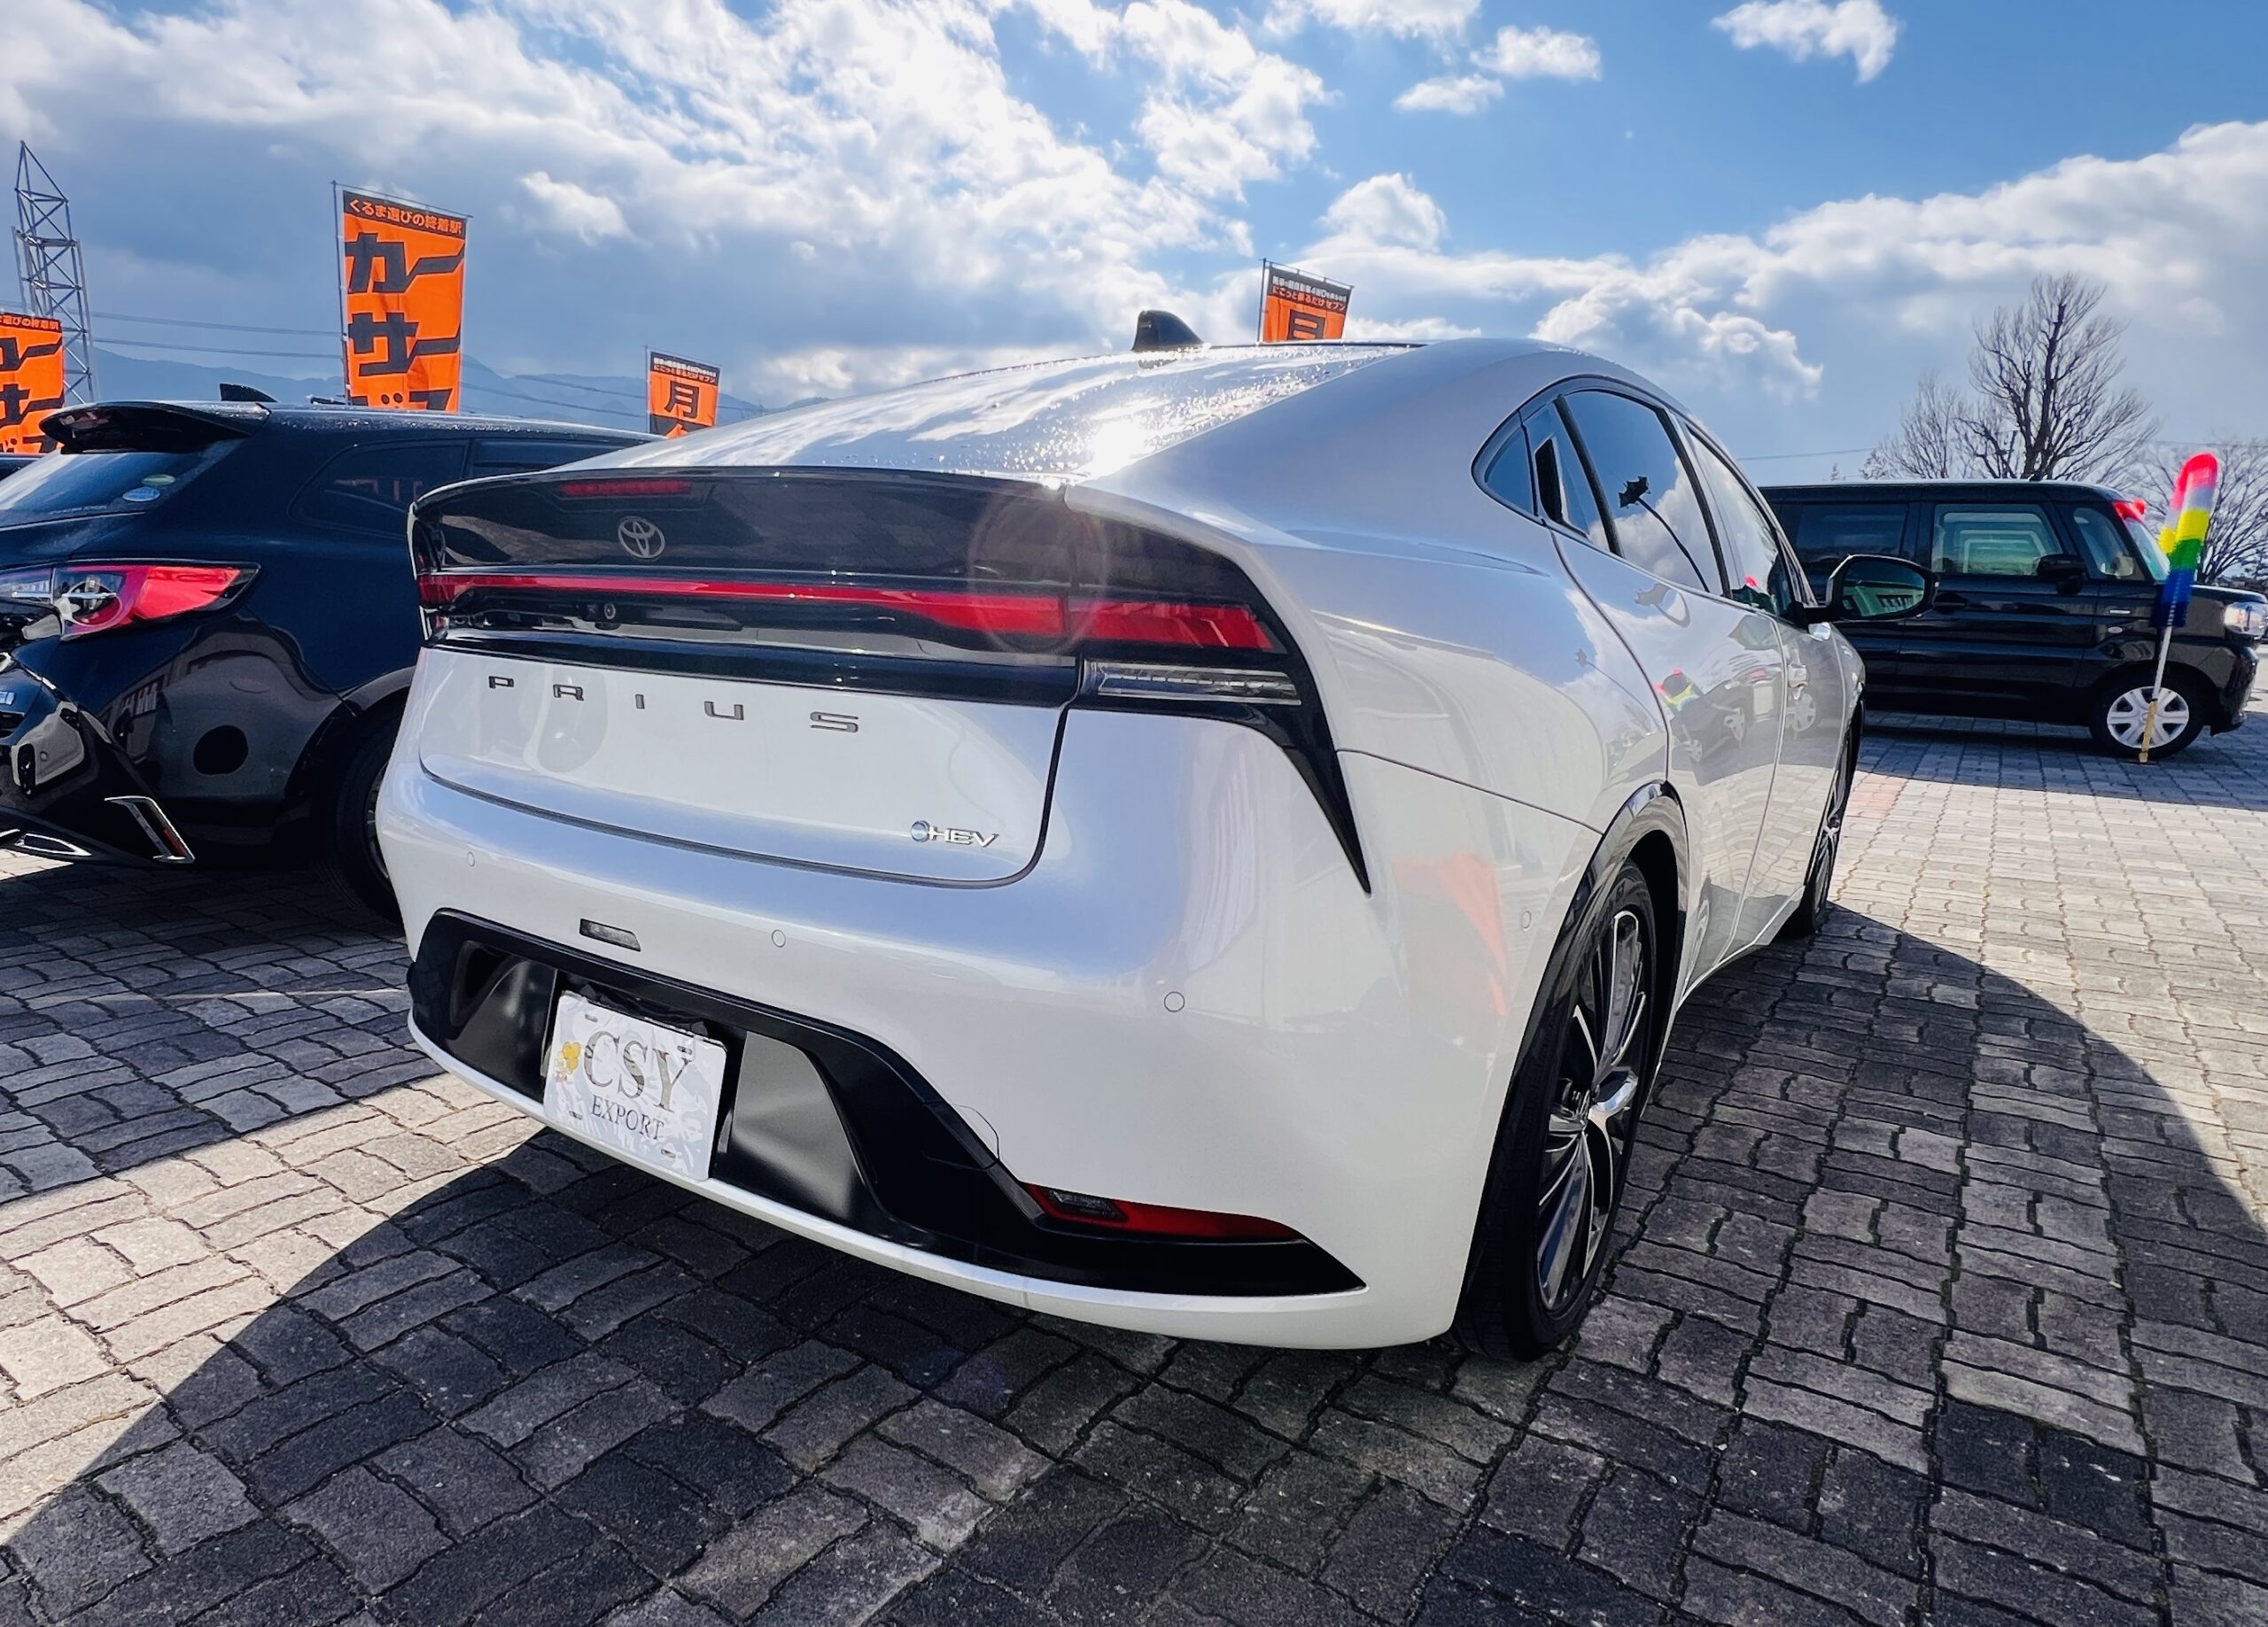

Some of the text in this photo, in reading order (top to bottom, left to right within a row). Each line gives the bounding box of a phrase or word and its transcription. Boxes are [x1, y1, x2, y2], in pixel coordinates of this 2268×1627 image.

[349, 198, 462, 234] くるま選びの終着駅
[664, 380, 700, 419] 月
[488, 675, 859, 733] PRIUS
[928, 825, 1000, 848] HEV
[584, 1030, 693, 1113] CSY
[591, 1094, 665, 1141] EXPORT
